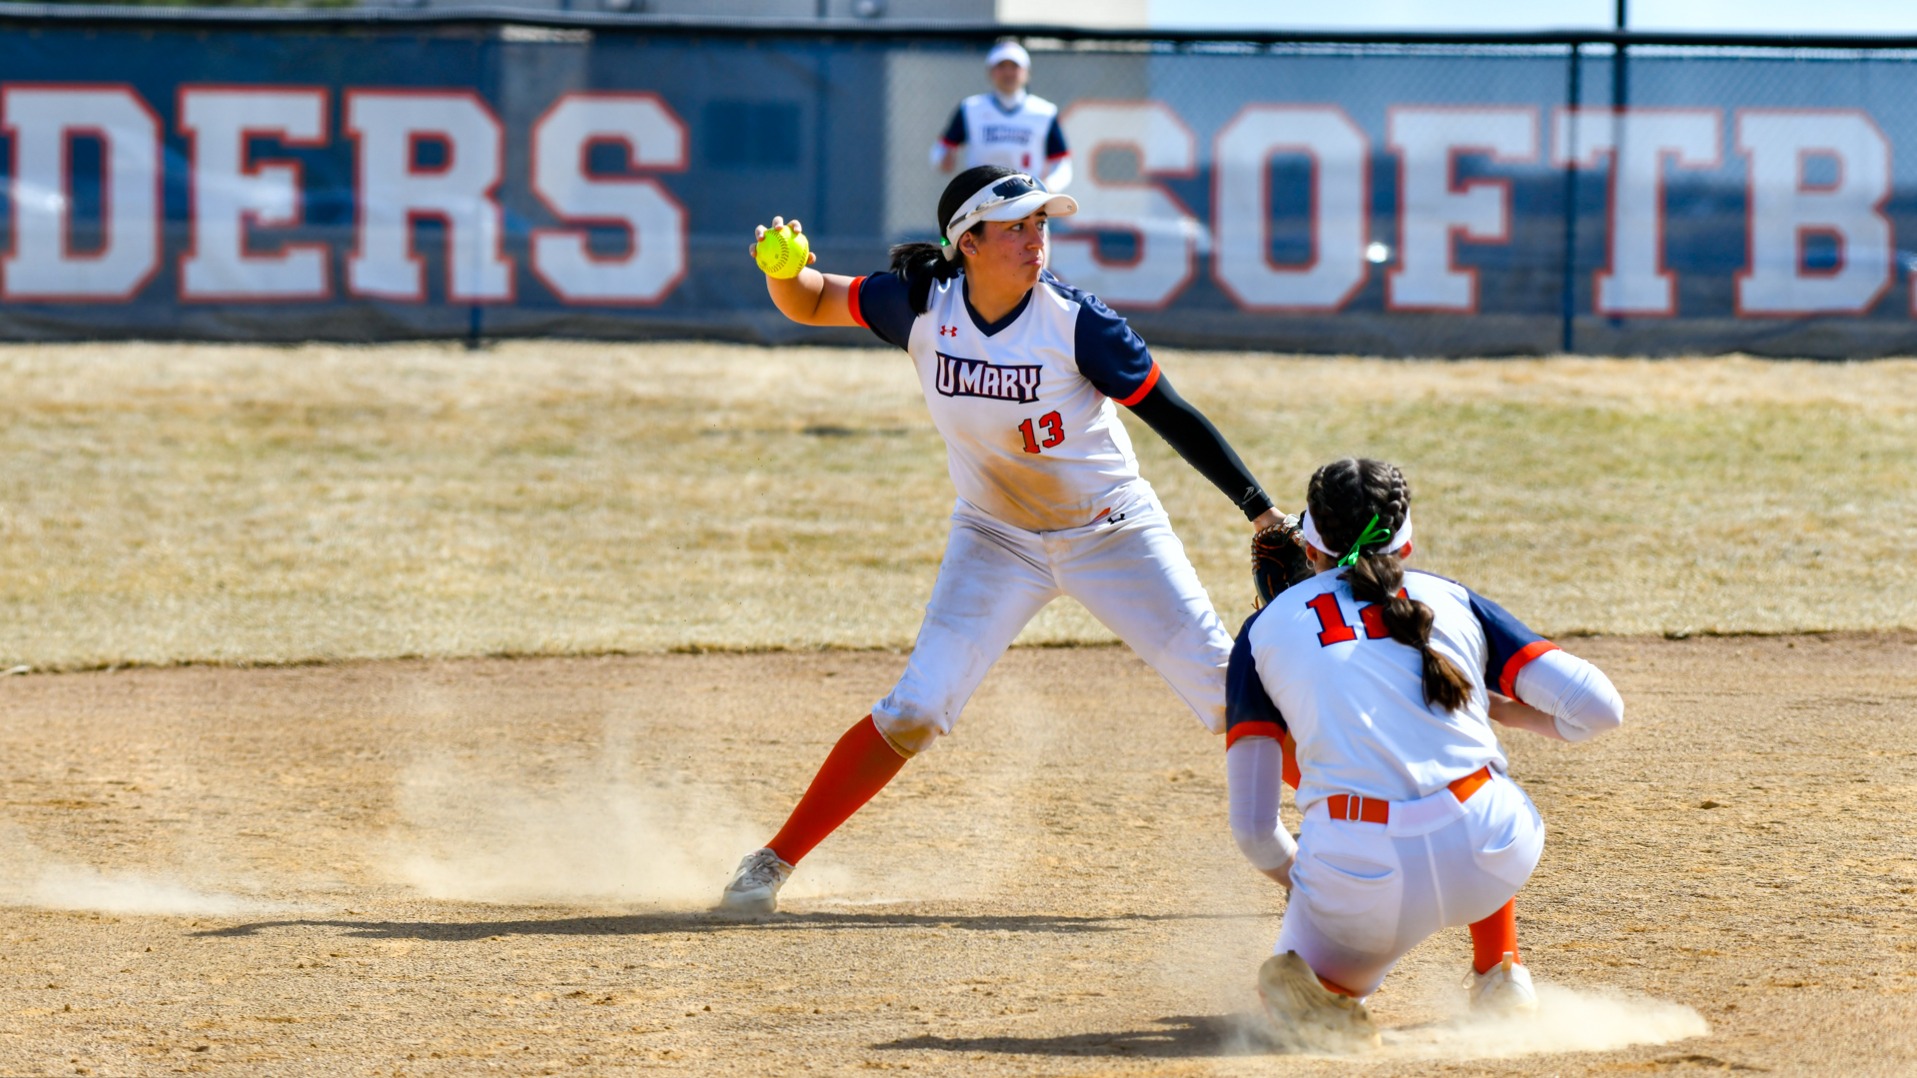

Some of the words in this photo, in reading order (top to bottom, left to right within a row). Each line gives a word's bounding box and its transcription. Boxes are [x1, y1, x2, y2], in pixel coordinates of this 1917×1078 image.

[0, 83, 689, 304] DERS
[1048, 98, 1917, 319] SOFTB
[936, 351, 1042, 403] UMARY
[1018, 410, 1065, 454] 13
